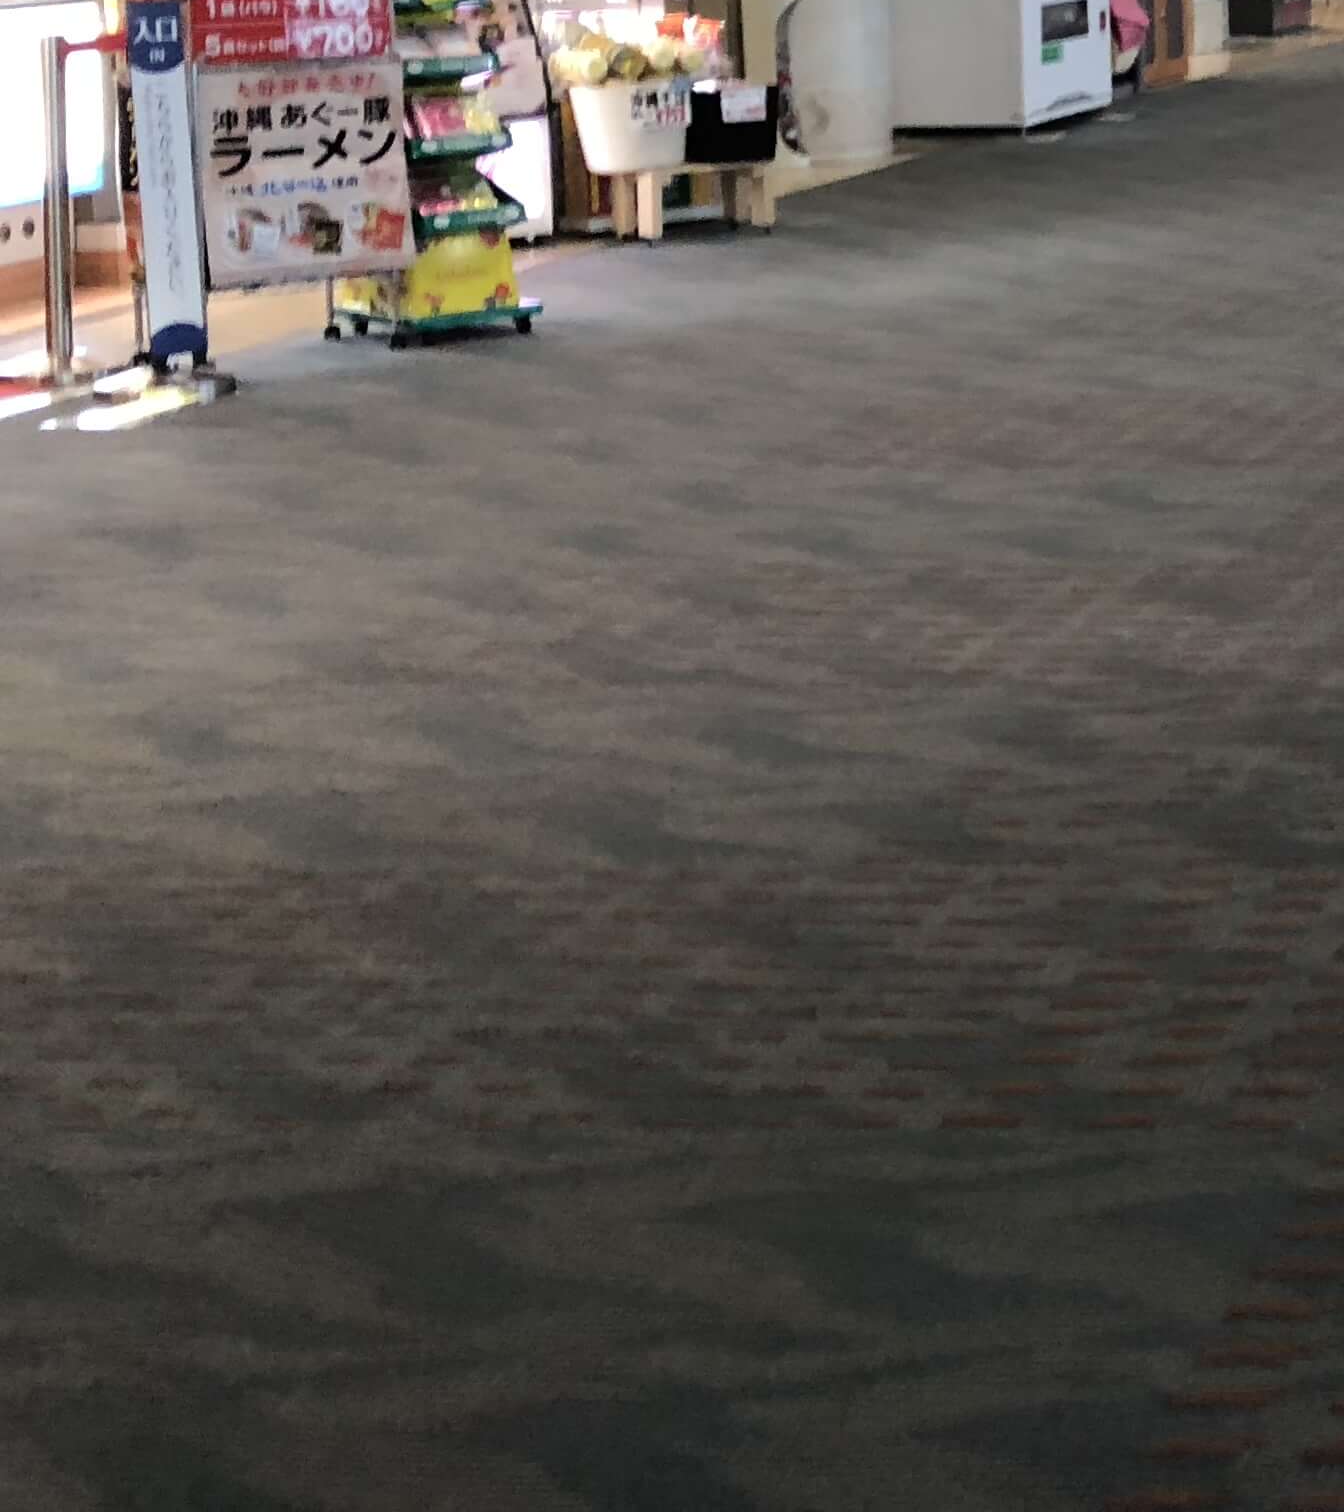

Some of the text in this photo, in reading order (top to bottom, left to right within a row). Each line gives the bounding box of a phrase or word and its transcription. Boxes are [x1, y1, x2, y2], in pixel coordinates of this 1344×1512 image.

[133, 15, 178, 44] 入口
[210, 129, 397, 178] ラーメン
